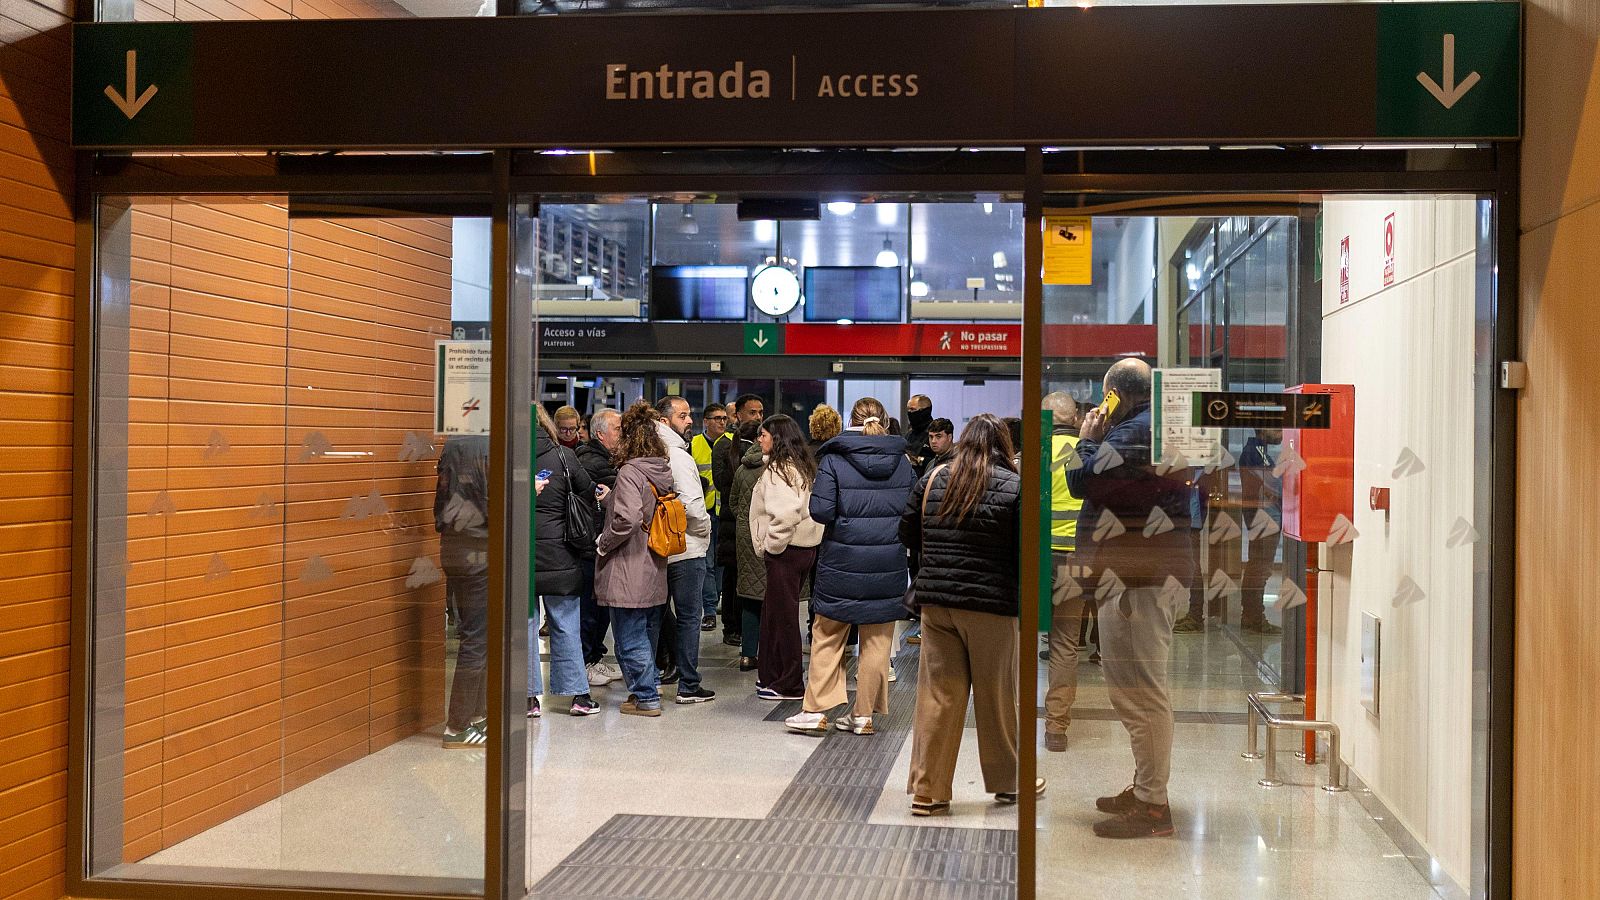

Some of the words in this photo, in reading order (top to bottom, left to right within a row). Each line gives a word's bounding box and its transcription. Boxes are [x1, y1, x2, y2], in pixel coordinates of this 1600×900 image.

[606, 61, 771, 100] Entrada
[817, 74, 919, 98] ACCESS
[543, 327, 576, 338] Acceso
[577, 329, 584, 338] a
[586, 327, 607, 338] vías
[961, 331, 975, 341] No
[978, 332, 1008, 344] pasar
